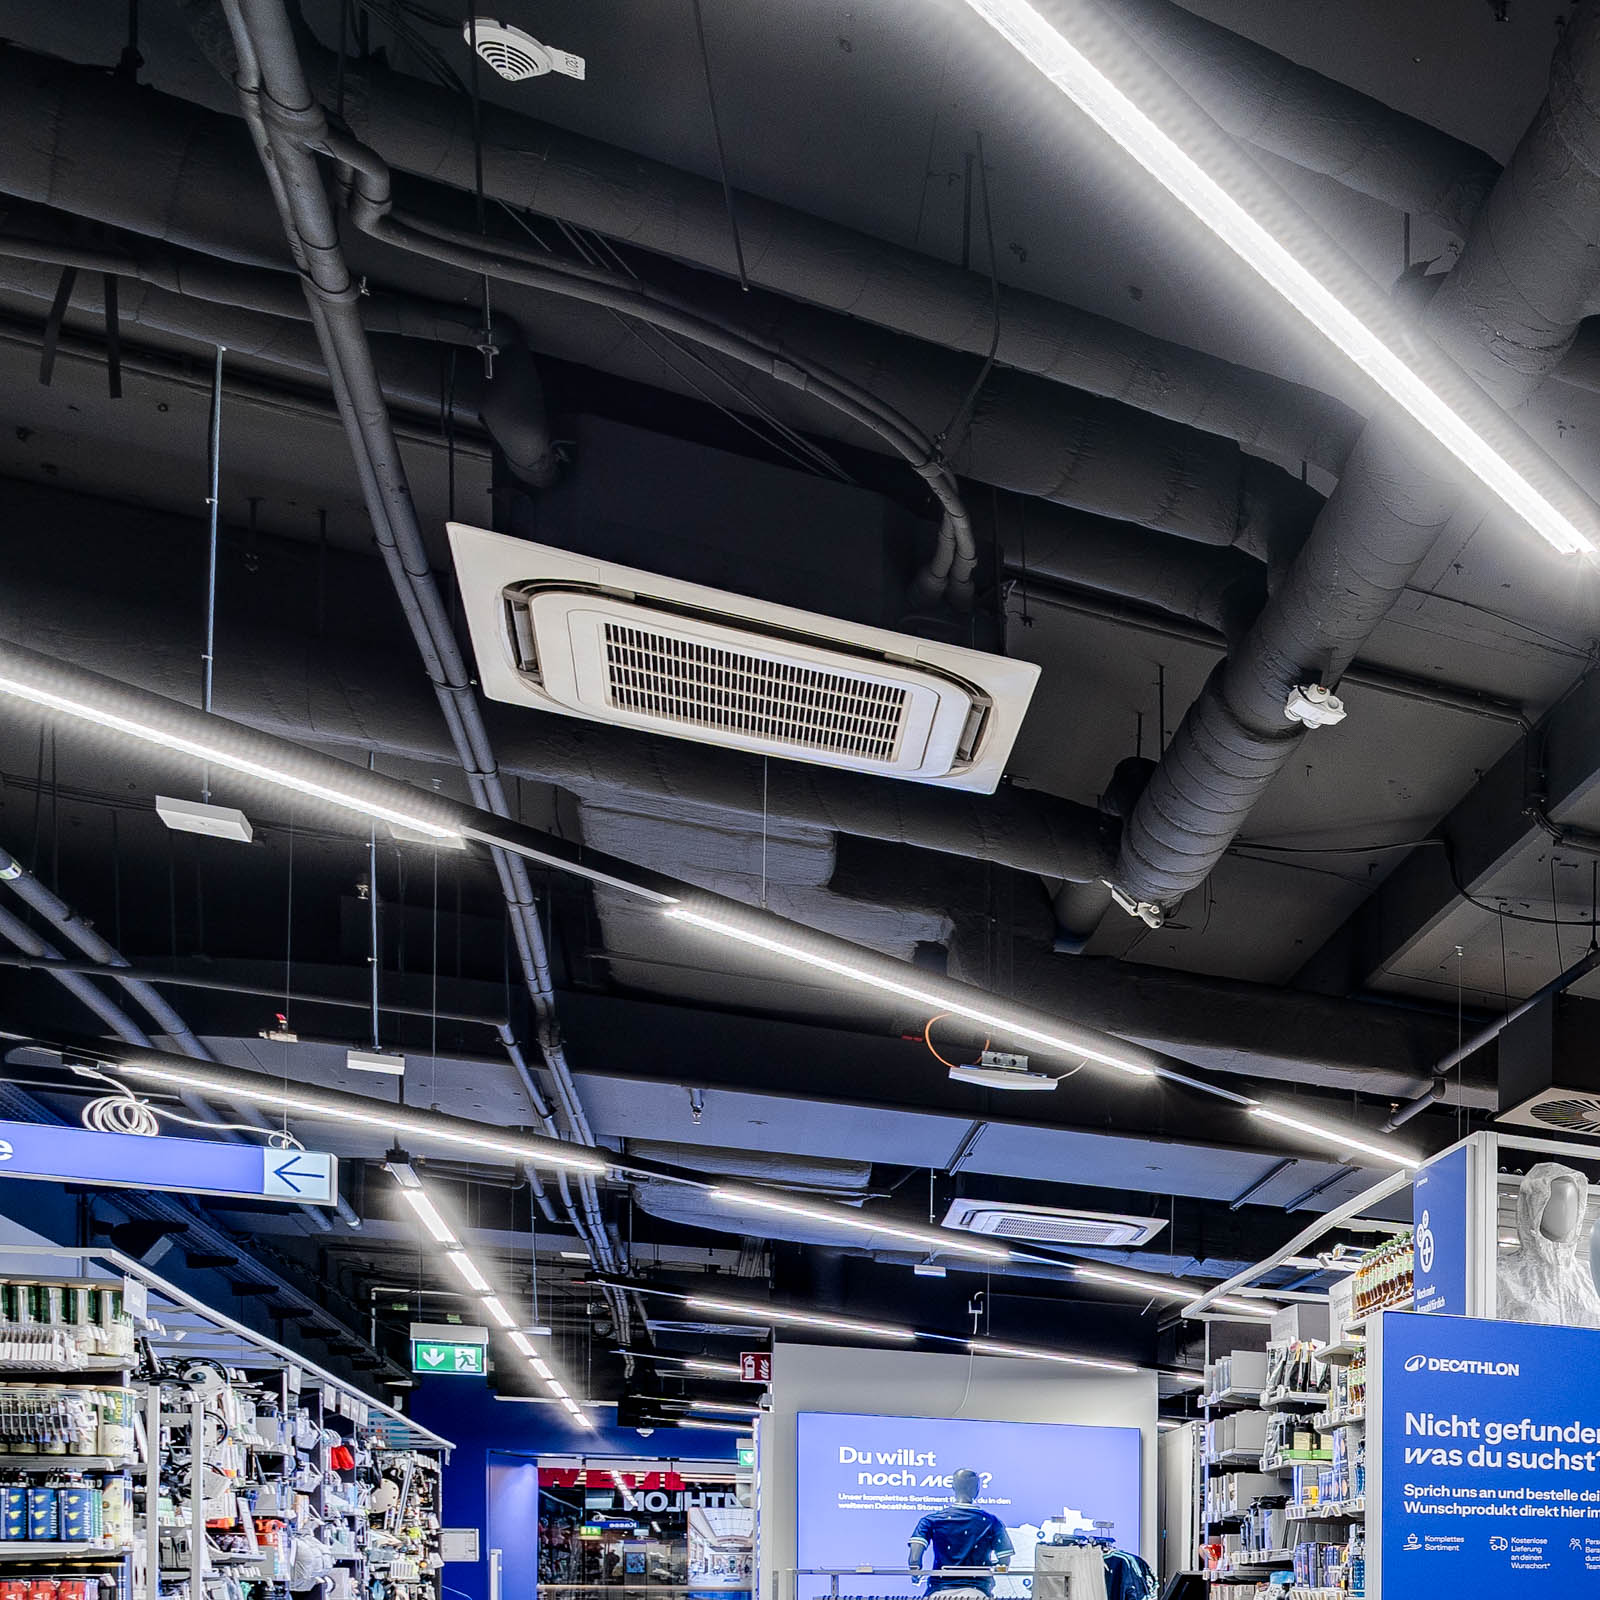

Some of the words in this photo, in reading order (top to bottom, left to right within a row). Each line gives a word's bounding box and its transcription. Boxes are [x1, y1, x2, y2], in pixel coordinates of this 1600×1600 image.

[1428, 1357, 1520, 1377] DECATHLON
[1405, 1412, 1481, 1439] Nicht
[839, 1446, 872, 1465] Du
[876, 1448, 937, 1467] willst
[1404, 1447, 1463, 1467] was
[1467, 1444, 1501, 1468] du
[857, 1470, 916, 1487] noch
[919, 1472, 993, 1488] me?
[838, 1493, 863, 1501] Unser
[1404, 1483, 1450, 1499] Sprich
[1452, 1488, 1478, 1498] uns
[1479, 1489, 1496, 1499] an
[1498, 1488, 1524, 1499] und
[1525, 1488, 1578, 1501] bestelle
[875, 1503, 916, 1511] Decathlon
[1404, 1501, 1518, 1518] Wunschprodukt
[1519, 1504, 1559, 1517] direkt
[1560, 1505, 1586, 1518] hier
[1424, 1535, 1464, 1544] Komplettes
[1511, 1537, 1548, 1545] Kostenlose
[1424, 1543, 1460, 1551] Sortiment
[1511, 1545, 1542, 1554] Lieferung
[1519, 1553, 1542, 1561] deinen
